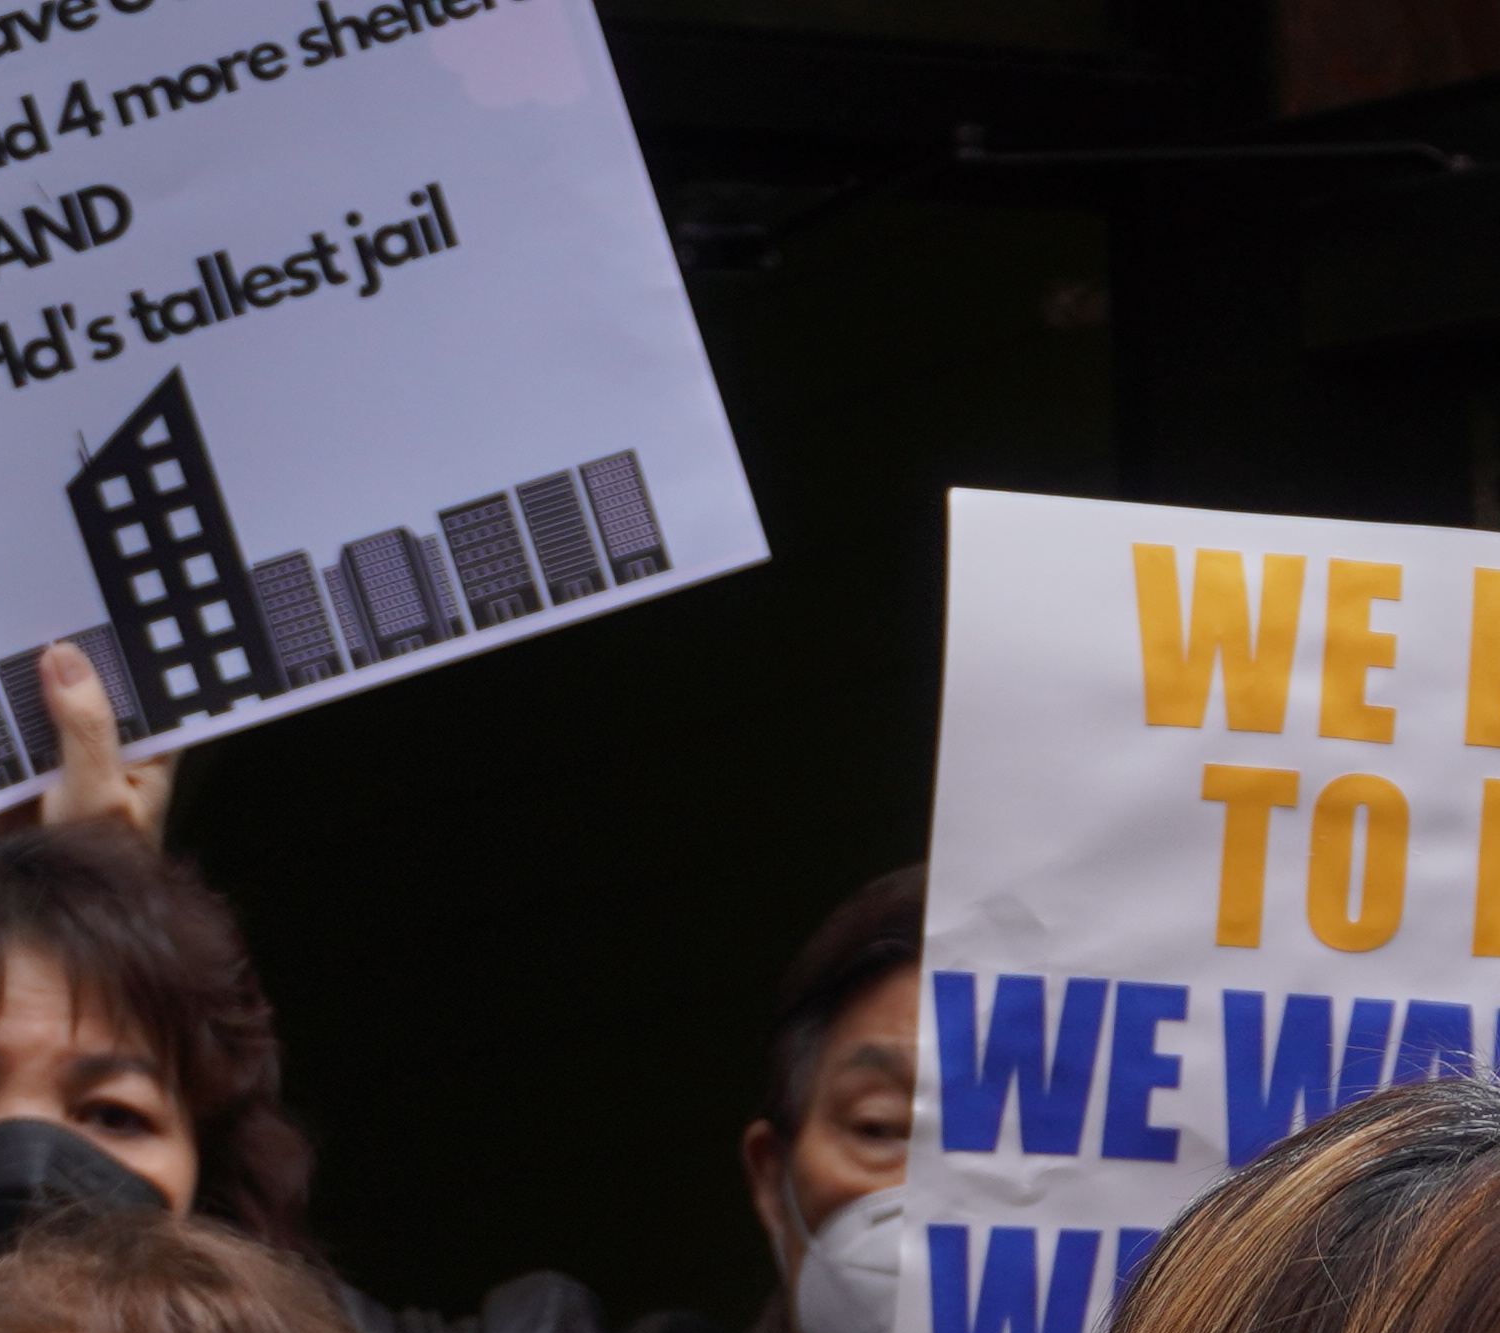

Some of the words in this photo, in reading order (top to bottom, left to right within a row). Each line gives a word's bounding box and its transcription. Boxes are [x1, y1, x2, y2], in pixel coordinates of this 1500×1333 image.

[57, 79, 105, 138] 4
[112, 41, 290, 127] more
[127, 232, 350, 348] tallest
[347, 183, 459, 301] jail
[1131, 542, 1403, 745] WE
[1201, 762, 1410, 953] TO
[932, 971, 1189, 1164] WE
